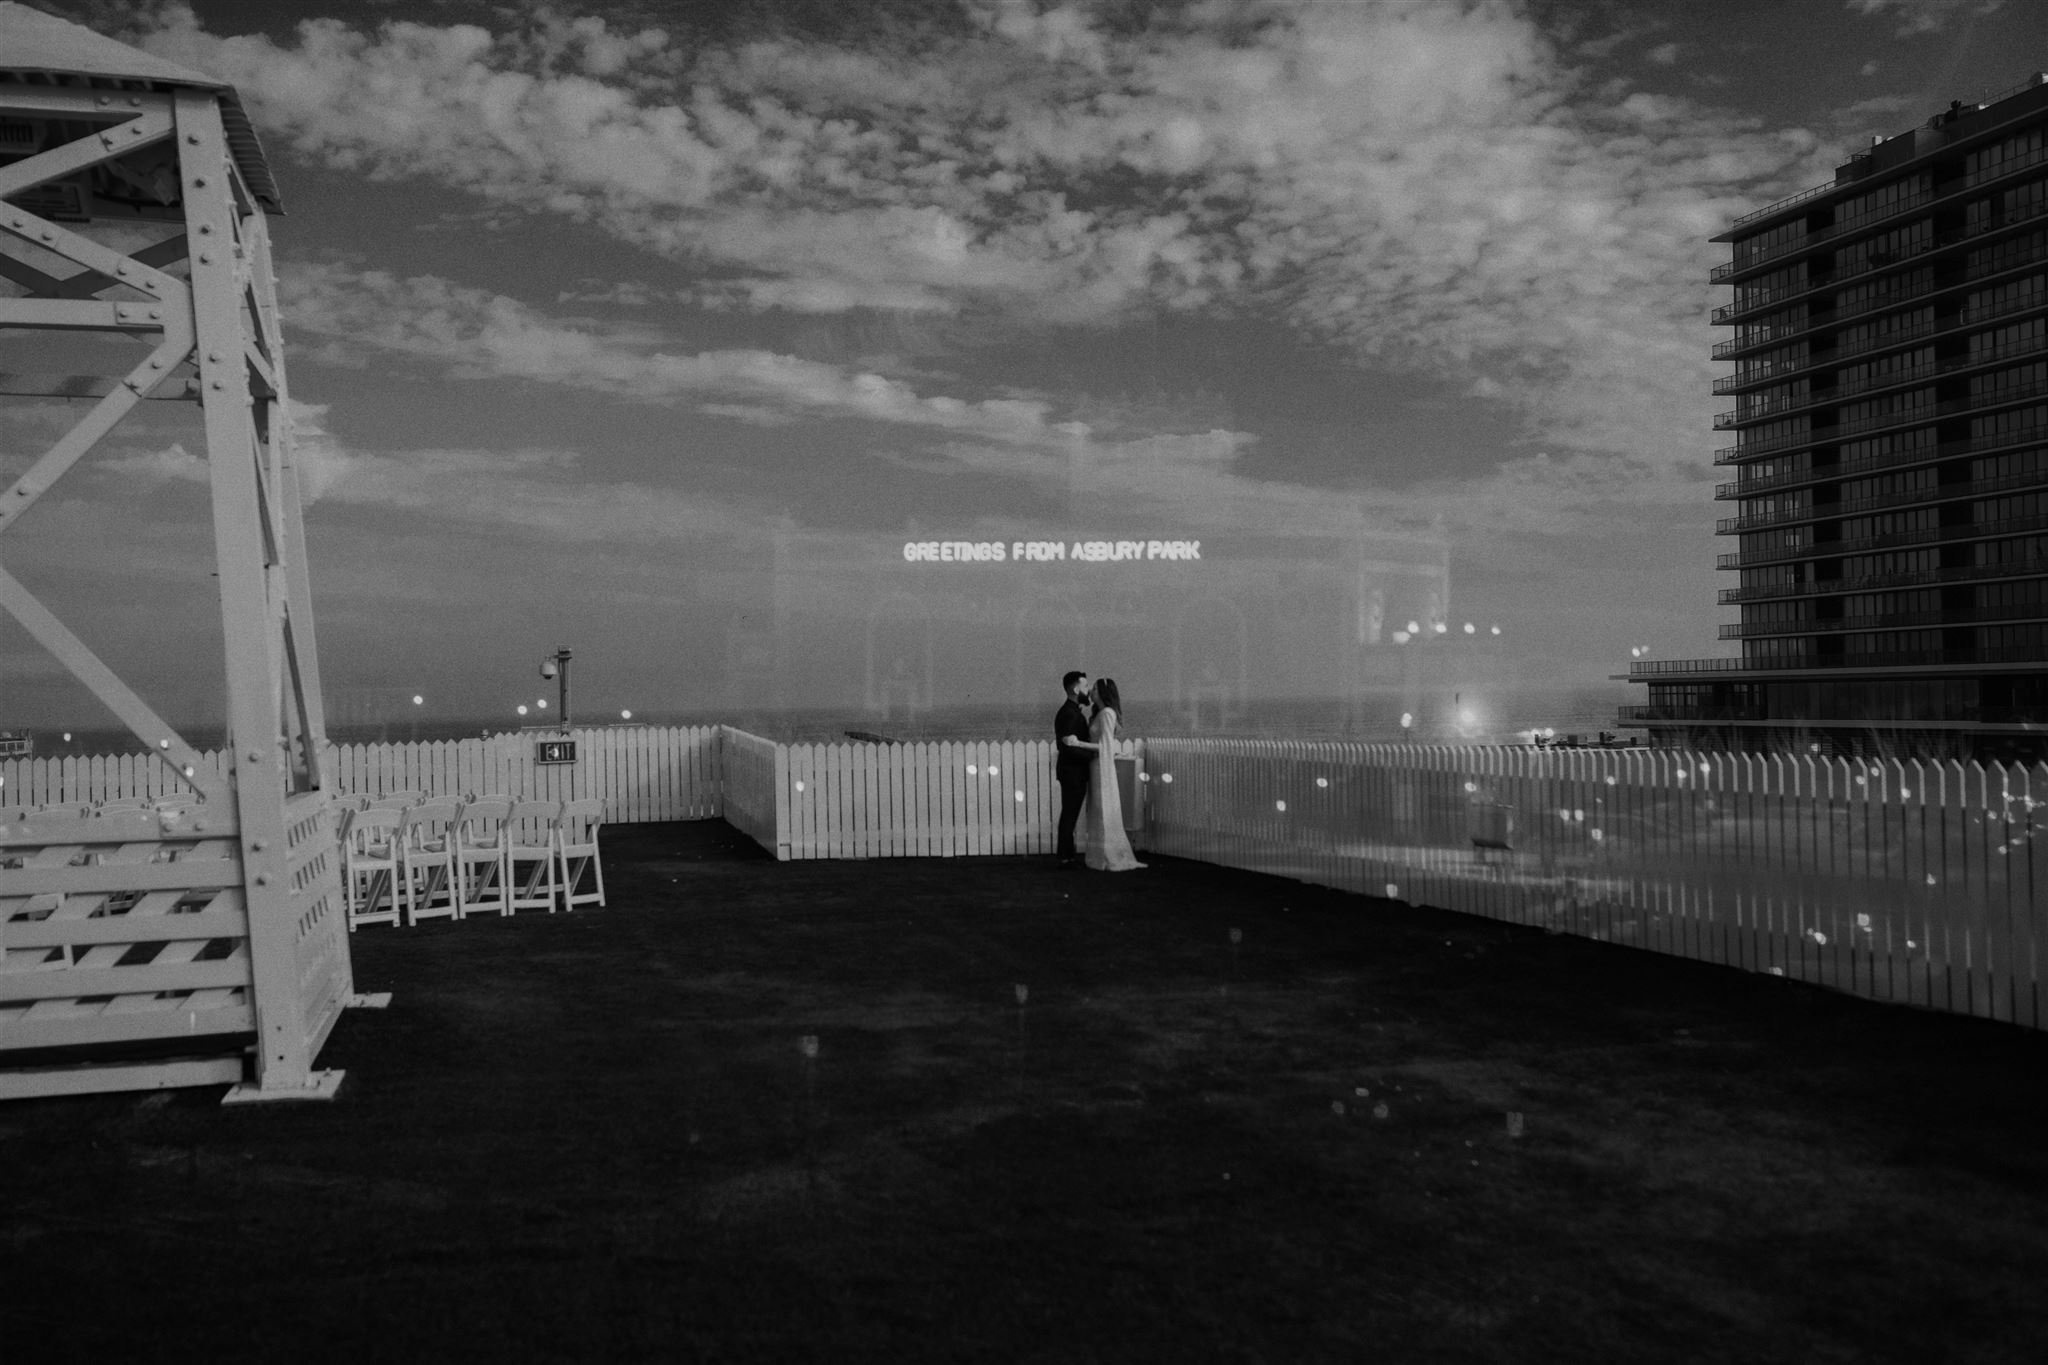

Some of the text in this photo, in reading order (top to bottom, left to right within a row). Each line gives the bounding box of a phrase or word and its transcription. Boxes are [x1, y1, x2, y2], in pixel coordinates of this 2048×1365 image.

[903, 540, 1201, 562] GREETINGS FROM ASBURY PARK
